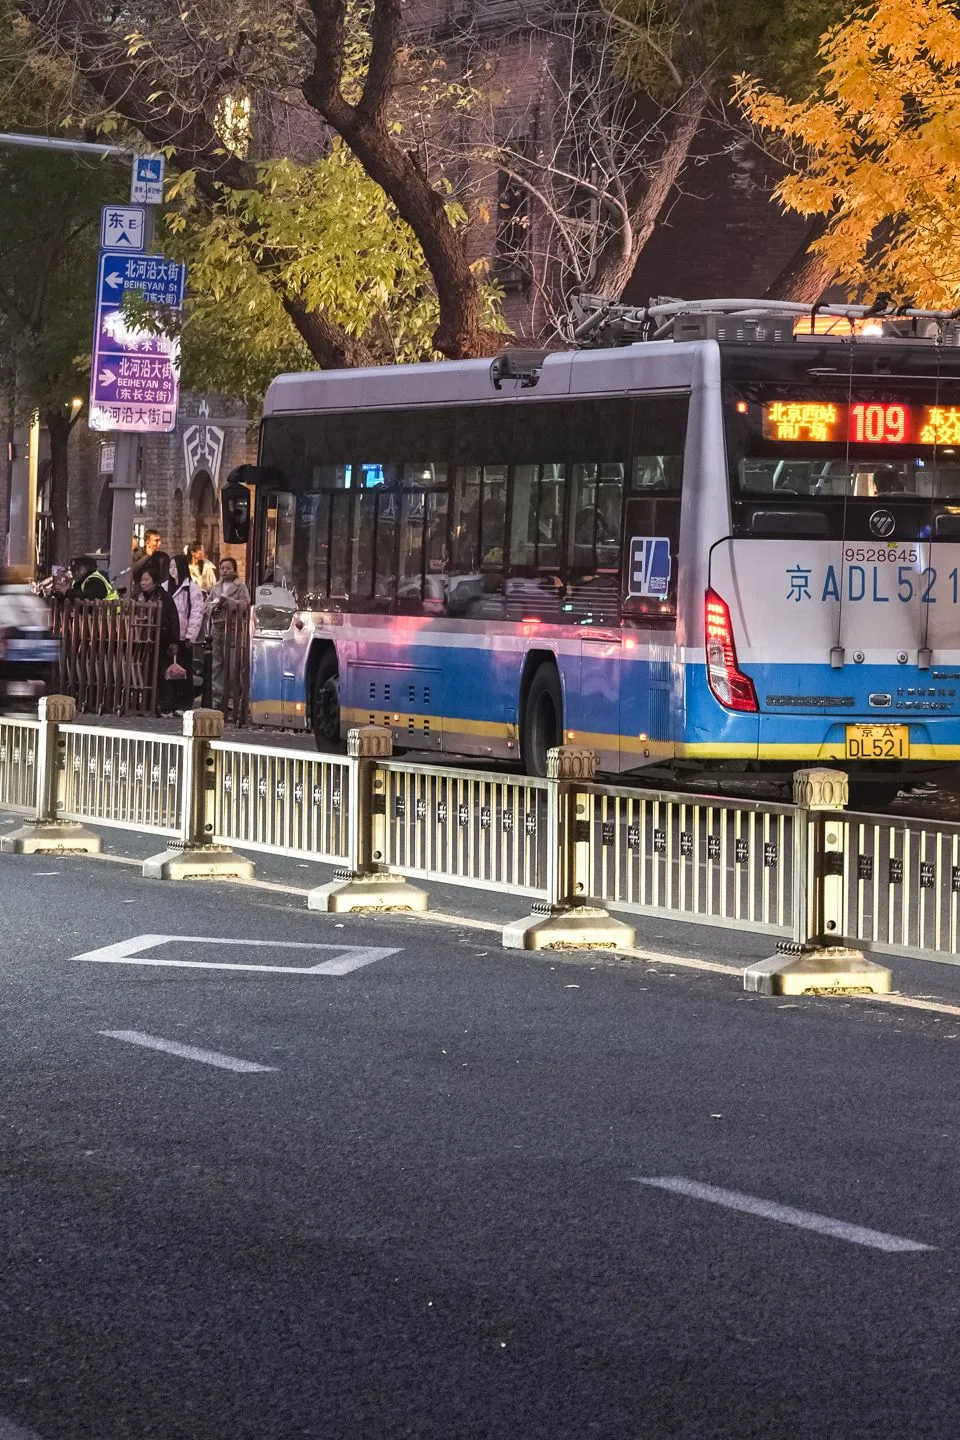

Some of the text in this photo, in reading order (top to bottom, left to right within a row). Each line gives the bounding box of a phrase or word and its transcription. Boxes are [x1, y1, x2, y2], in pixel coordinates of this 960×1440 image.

[108, 212, 137, 229] 东 E
[125, 259, 180, 281] 北河沿大街
[124, 280, 177, 292] BEIHEYAN St
[119, 358, 172, 380] 北河沿大街
[117, 377, 172, 390] BEIHEYAN St
[769, 403, 836, 423] 北京西站
[853, 405, 904, 442] 109
[845, 548, 918, 563] 9528645
[786, 565, 959, 604] 京ADL521
[850, 739, 903, 758] DL521
